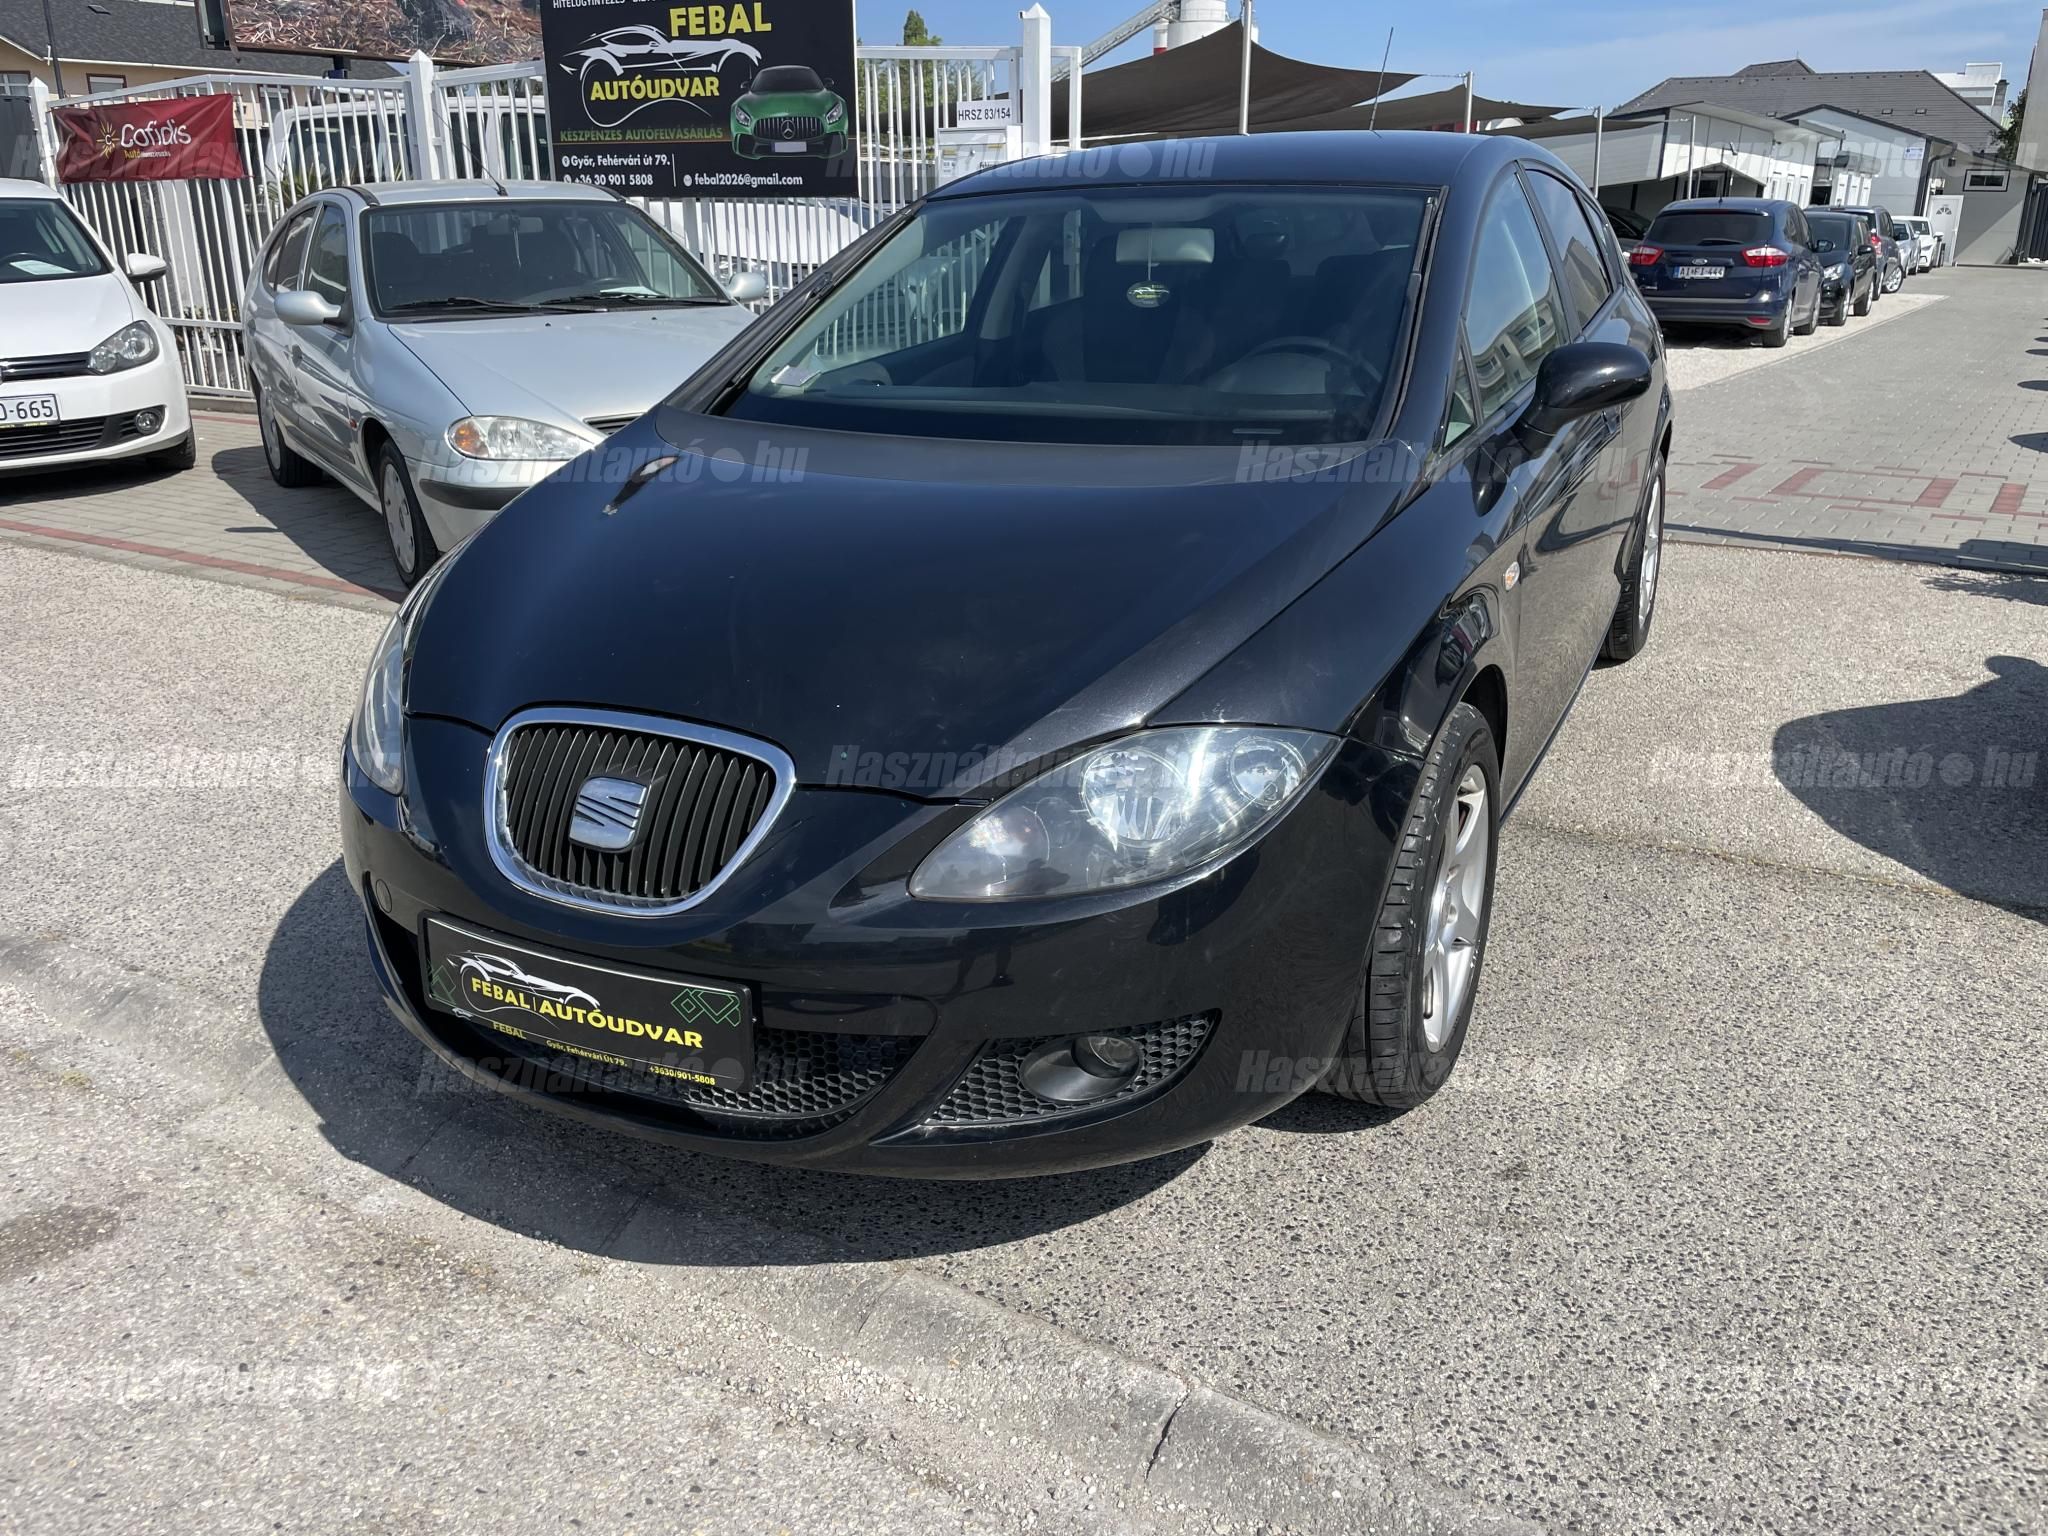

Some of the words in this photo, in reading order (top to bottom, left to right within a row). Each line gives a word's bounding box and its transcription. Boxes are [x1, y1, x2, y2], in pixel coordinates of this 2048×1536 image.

[669, 2, 772, 37] FEBAL
[590, 74, 720, 101] AUTÓUDVAR
[958, 108, 982, 121] HRSZ
[984, 107, 1011, 120] 83/154
[120, 119, 192, 148] Cofidis
[560, 126, 623, 142] KÉSZPÉNZES
[625, 125, 724, 141] AUTÓFELVÁSÁRLÁS
[571, 155, 596, 169] Győr,
[597, 154, 641, 166] Fehérvári
[643, 154, 653, 166] út
[655, 154, 671, 166] 79.
[594, 174, 606, 186] 30
[608, 174, 626, 186] 901
[629, 174, 654, 186] 5808
[694, 172, 804, 188] febal2026@gmail.com
[471, 977, 531, 1010] FEBAL
[539, 999, 703, 1049] AUTÓUDVAR
[492, 1021, 527, 1040] FEBAL
[649, 1066, 716, 1086] +3630/901-5808
